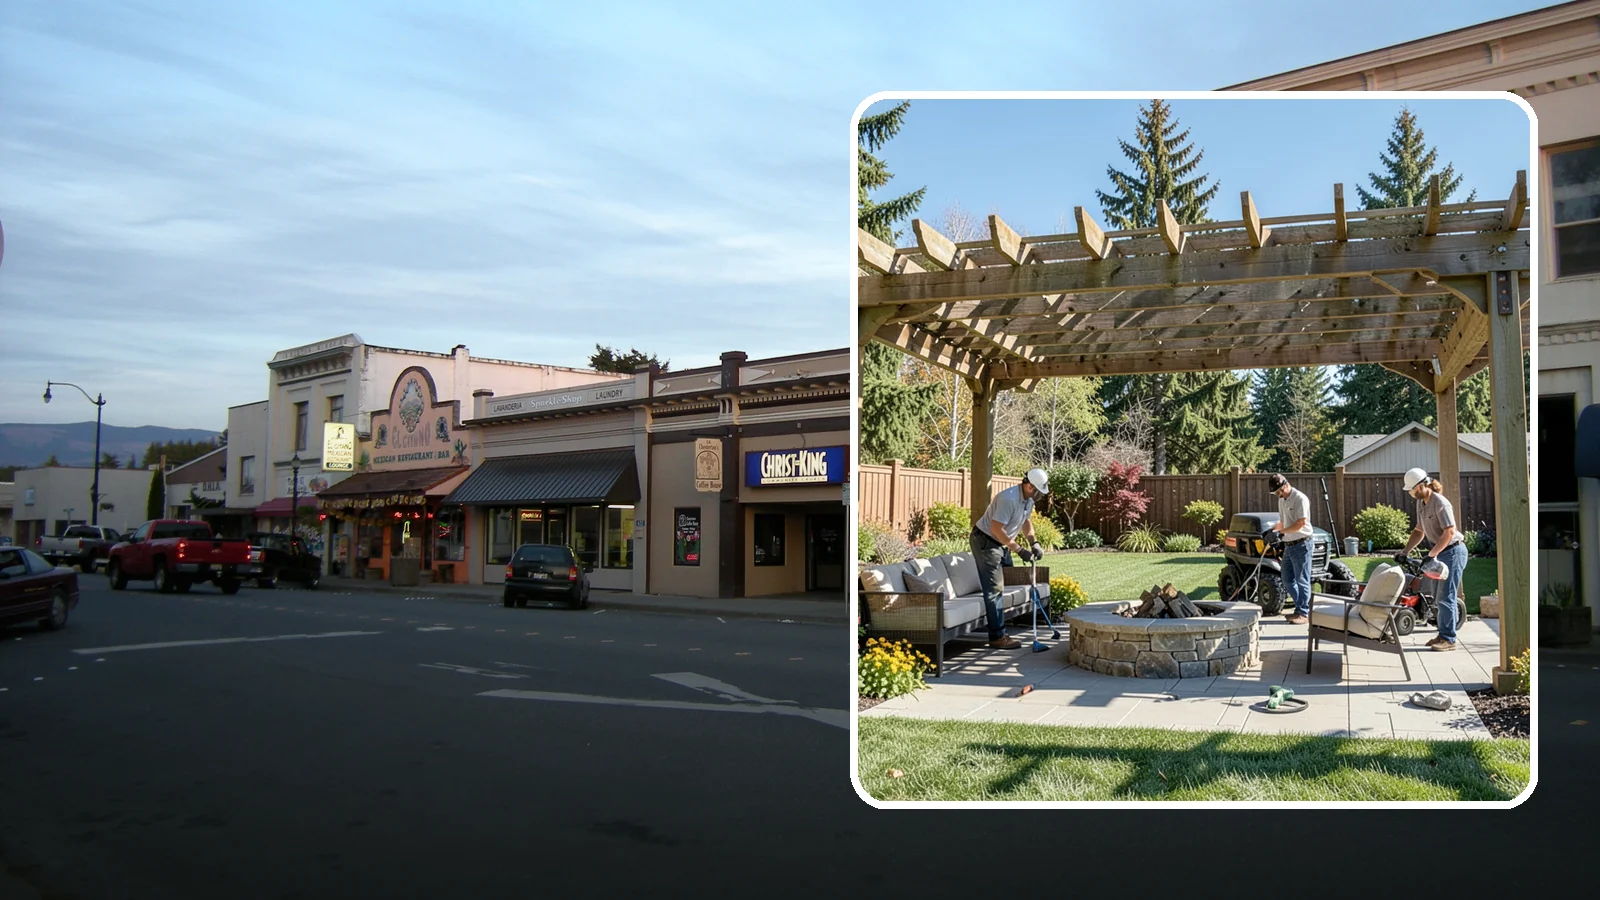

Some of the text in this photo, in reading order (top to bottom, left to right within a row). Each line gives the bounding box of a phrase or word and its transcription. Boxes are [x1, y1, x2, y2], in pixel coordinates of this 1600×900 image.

[493, 389, 624, 412] LAVANDERIA Sparkle Shop LAUNDRY
[373, 455, 396, 464] MEXICAN
[397, 451, 433, 462] RESTAURANT
[438, 449, 450, 459] BAR
[761, 450, 827, 478] CHRIST KING
[697, 480, 709, 489] Coffee
